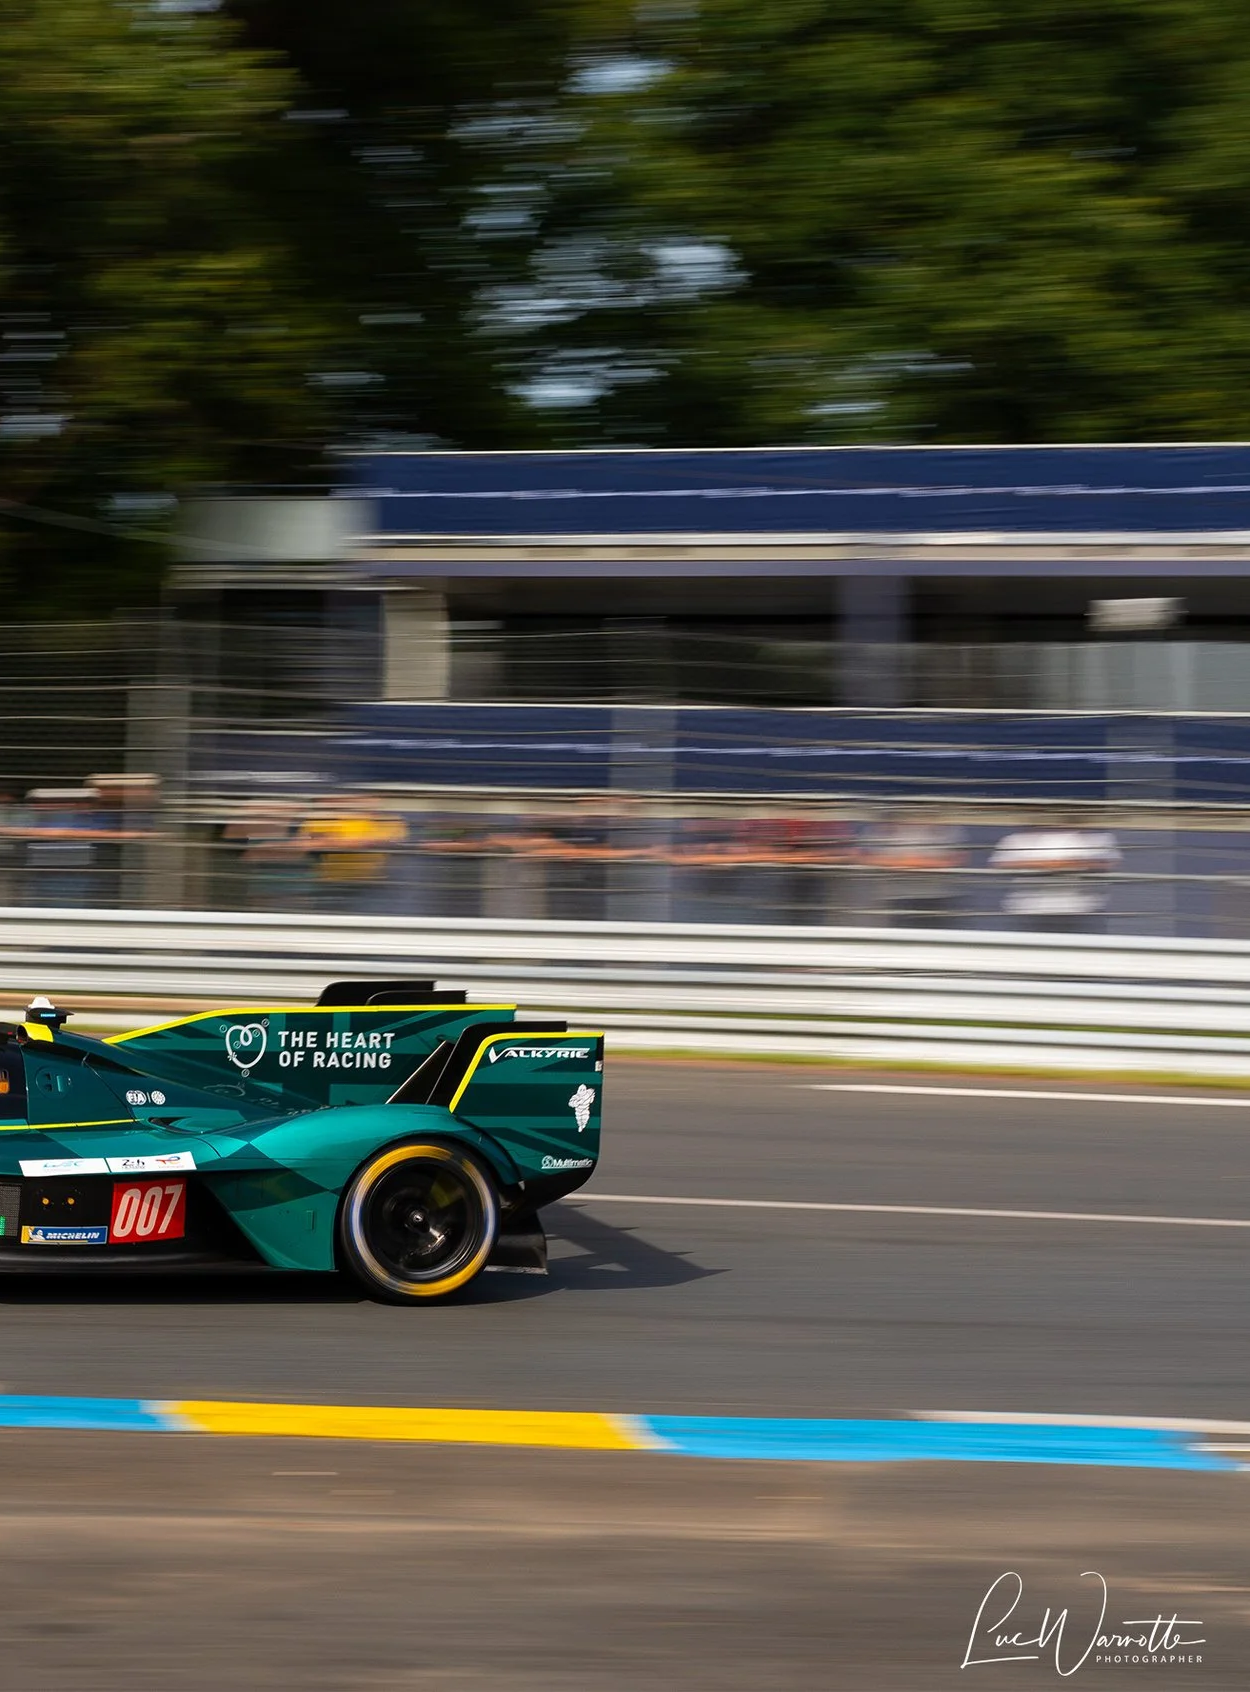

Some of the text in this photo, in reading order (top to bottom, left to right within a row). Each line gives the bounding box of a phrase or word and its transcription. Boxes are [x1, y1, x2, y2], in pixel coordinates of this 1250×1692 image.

[278, 1031, 395, 1049] THE HEART
[278, 1051, 392, 1068] OF RACING
[489, 1046, 590, 1064] VALKYRIE
[112, 1184, 184, 1238] 007
[46, 1231, 100, 1240] MICHELIN
